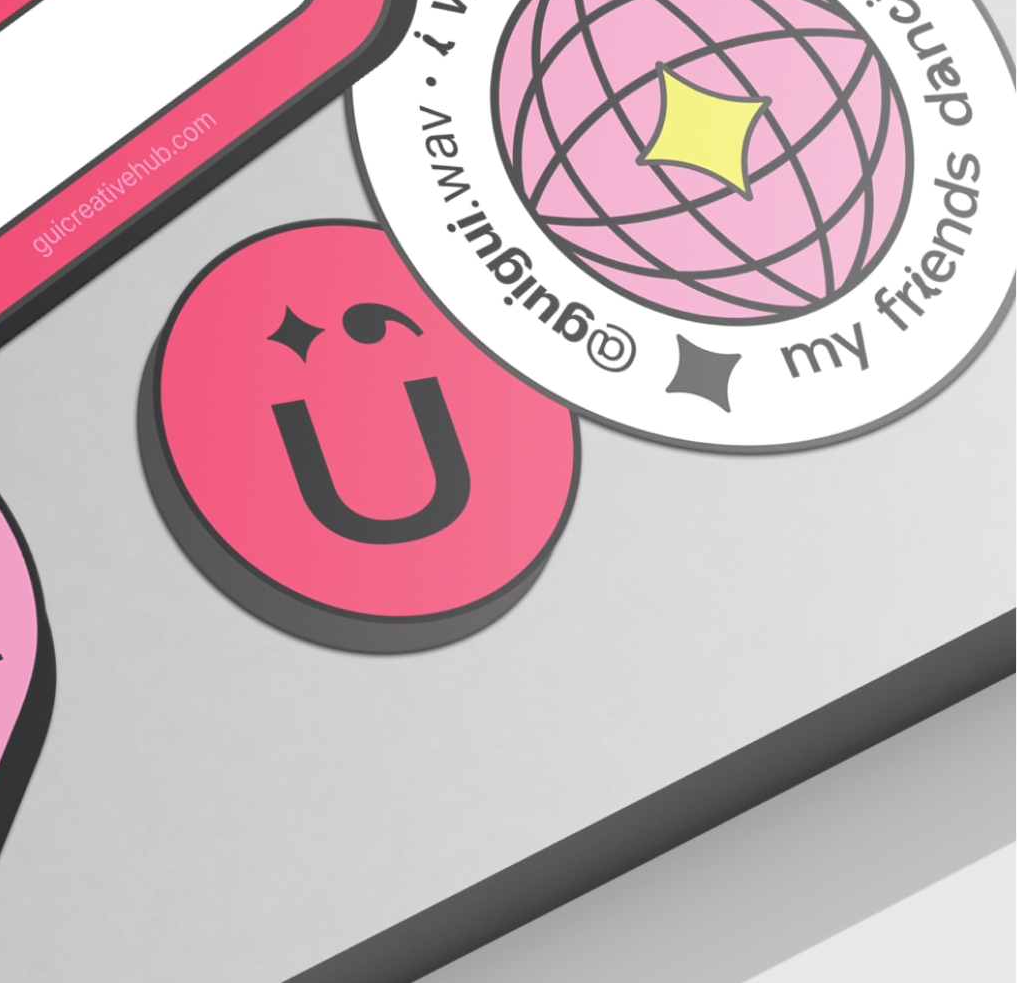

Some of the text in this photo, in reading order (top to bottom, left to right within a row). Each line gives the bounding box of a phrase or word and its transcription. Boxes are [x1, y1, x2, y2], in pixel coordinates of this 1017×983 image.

[30, 107, 219, 259] guicreativehub.com
[418, 104, 638, 373] @guigui.wav
[779, 321, 871, 379] my
[873, 150, 982, 333] friends
